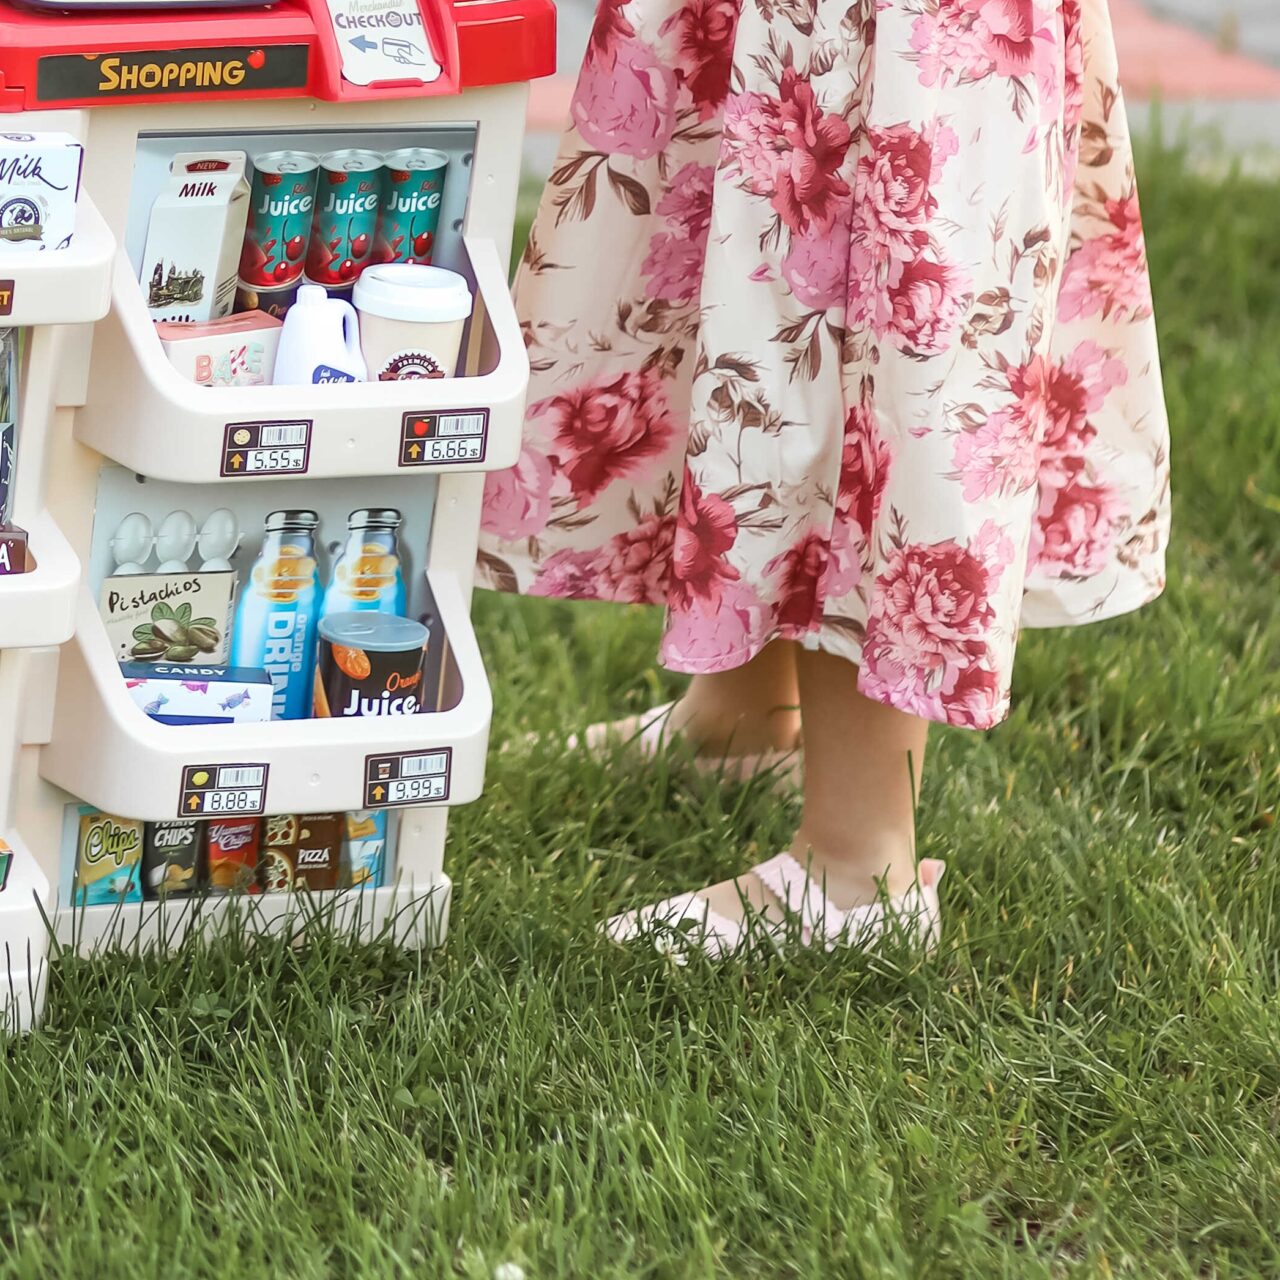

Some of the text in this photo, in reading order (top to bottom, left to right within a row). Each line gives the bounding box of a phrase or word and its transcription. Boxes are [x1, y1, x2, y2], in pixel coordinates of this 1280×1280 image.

[334, 11, 422, 29] CHECKOUT
[98, 57, 246, 91] SHOPPING
[195, 161, 219, 170] NEW
[178, 182, 218, 198] Milk
[258, 193, 312, 217] Juice
[323, 192, 378, 215] Juice
[387, 191, 440, 213] Juice
[397, 358, 433, 372] PREMIUM
[108, 578, 202, 613] Pistachios
[290, 614, 308, 672] orange
[154, 667, 227, 677] CANDY
[84, 819, 140, 866] Chips
[153, 827, 195, 847] CHIPS
